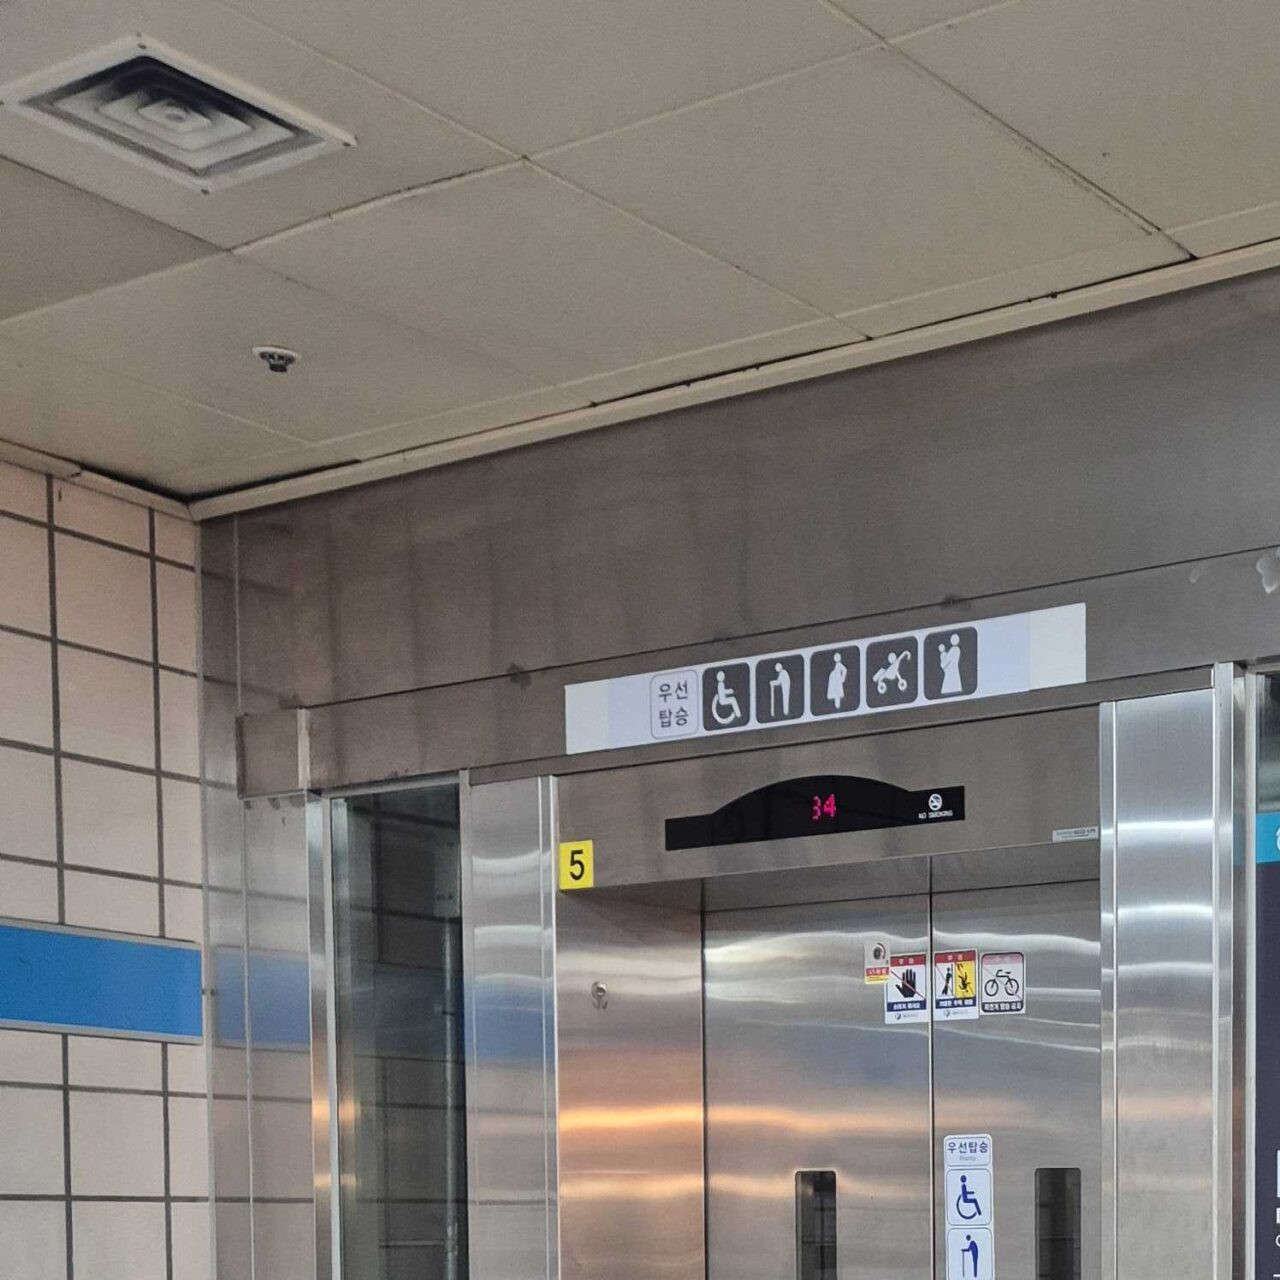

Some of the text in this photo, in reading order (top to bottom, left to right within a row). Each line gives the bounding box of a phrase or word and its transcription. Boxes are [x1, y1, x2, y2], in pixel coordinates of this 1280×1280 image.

[658, 681, 689, 702] 우선
[658, 706, 689, 728] 탑승
[569, 850, 585, 880] 5
[947, 1141, 988, 1154] 우선탑승
